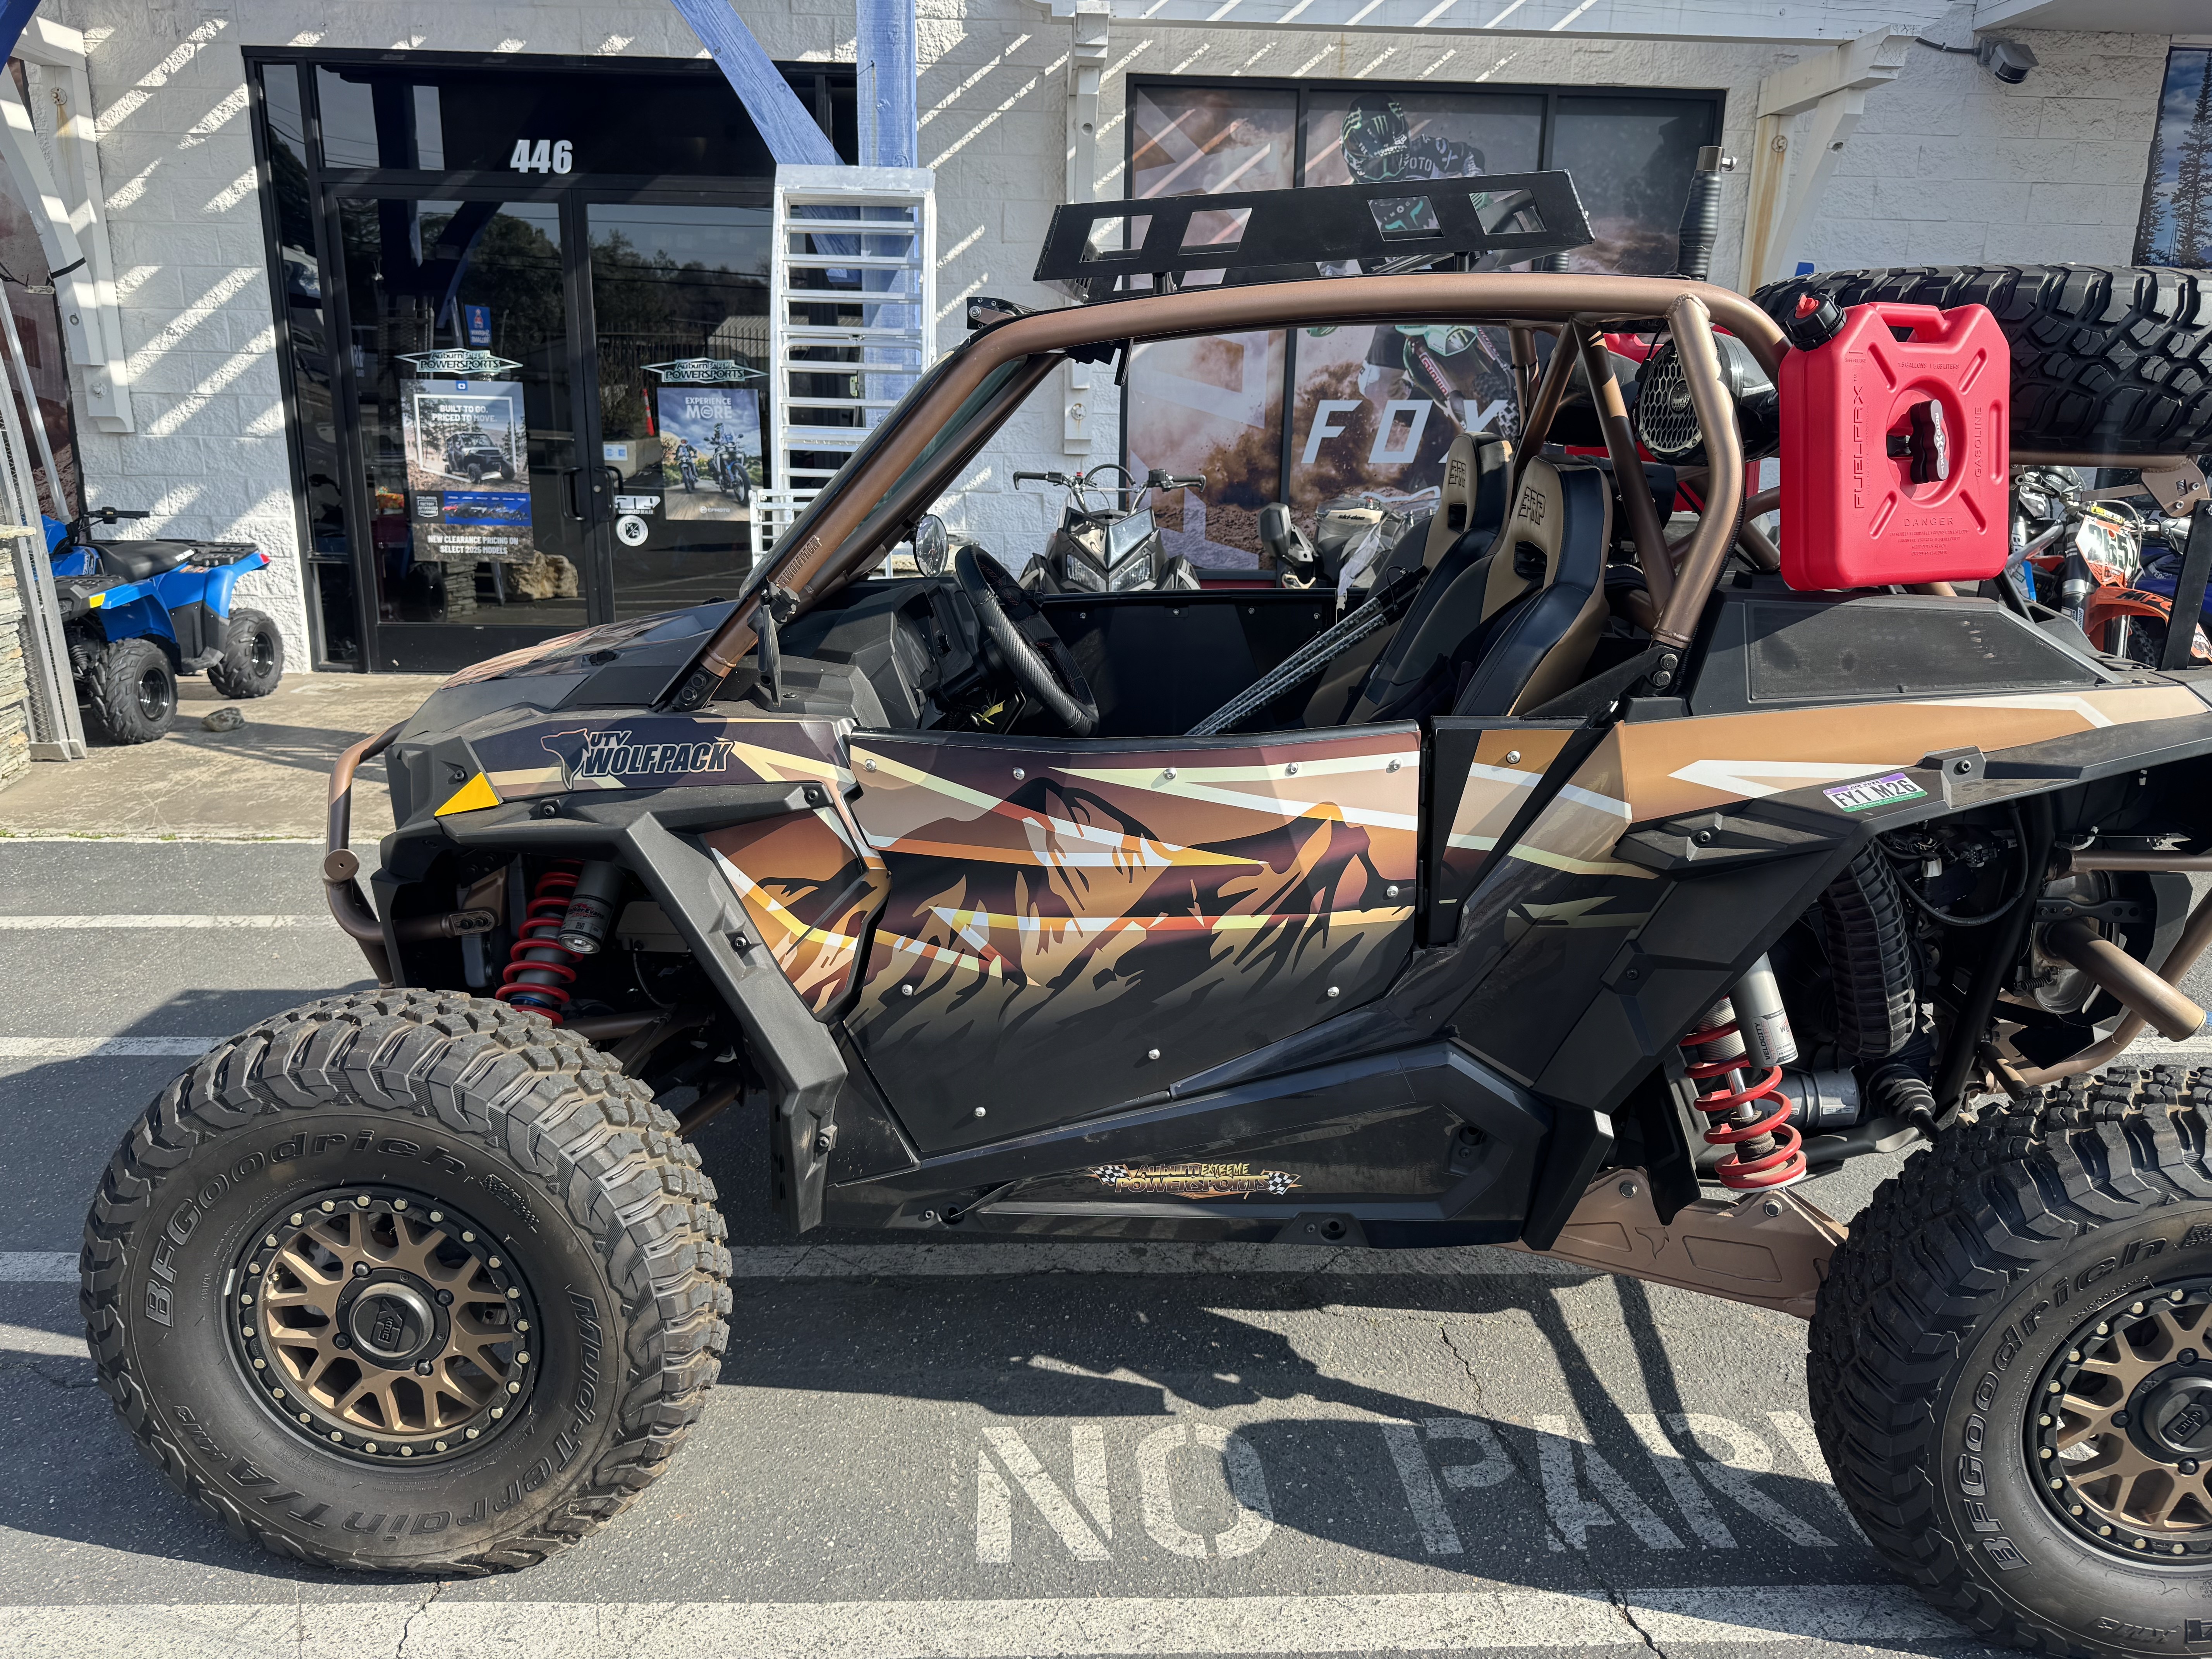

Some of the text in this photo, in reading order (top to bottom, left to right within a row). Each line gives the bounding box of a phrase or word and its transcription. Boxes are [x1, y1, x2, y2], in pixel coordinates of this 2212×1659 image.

[510, 139, 573, 174] 446
[420, 360, 500, 369] POWERSPORTS
[677, 362, 708, 370] Auburn
[665, 369, 744, 379] POWERSPORTS
[685, 397, 732, 405] EXPERIENCE
[439, 404, 488, 414] BUILT TO GO.
[686, 405, 732, 419] MORE
[432, 413, 497, 422] PRICED TO MOVE.
[1853, 385, 1864, 509] FUELPAX
[1904, 517, 1953, 526] DANGER
[428, 535, 519, 545] NEW CLEARANCE PRICING ON
[440, 545, 464, 553] SELECT
[483, 547, 508, 555] MODELS
[590, 731, 632, 748] UTV
[584, 741, 734, 776] WOLFPACK
[1832, 780, 1917, 807] FY1 M26
[1754, 1022, 1771, 1060] VELOCITY
[1137, 1163, 1250, 1176] Auburn EXTREME
[1115, 1175, 1270, 1193] POWERSPORTS
[144, 1129, 467, 1328] BFGoodrich
[1959, 1237, 2167, 1571] BFGoodrich
[977, 1423, 1274, 1564] NO
